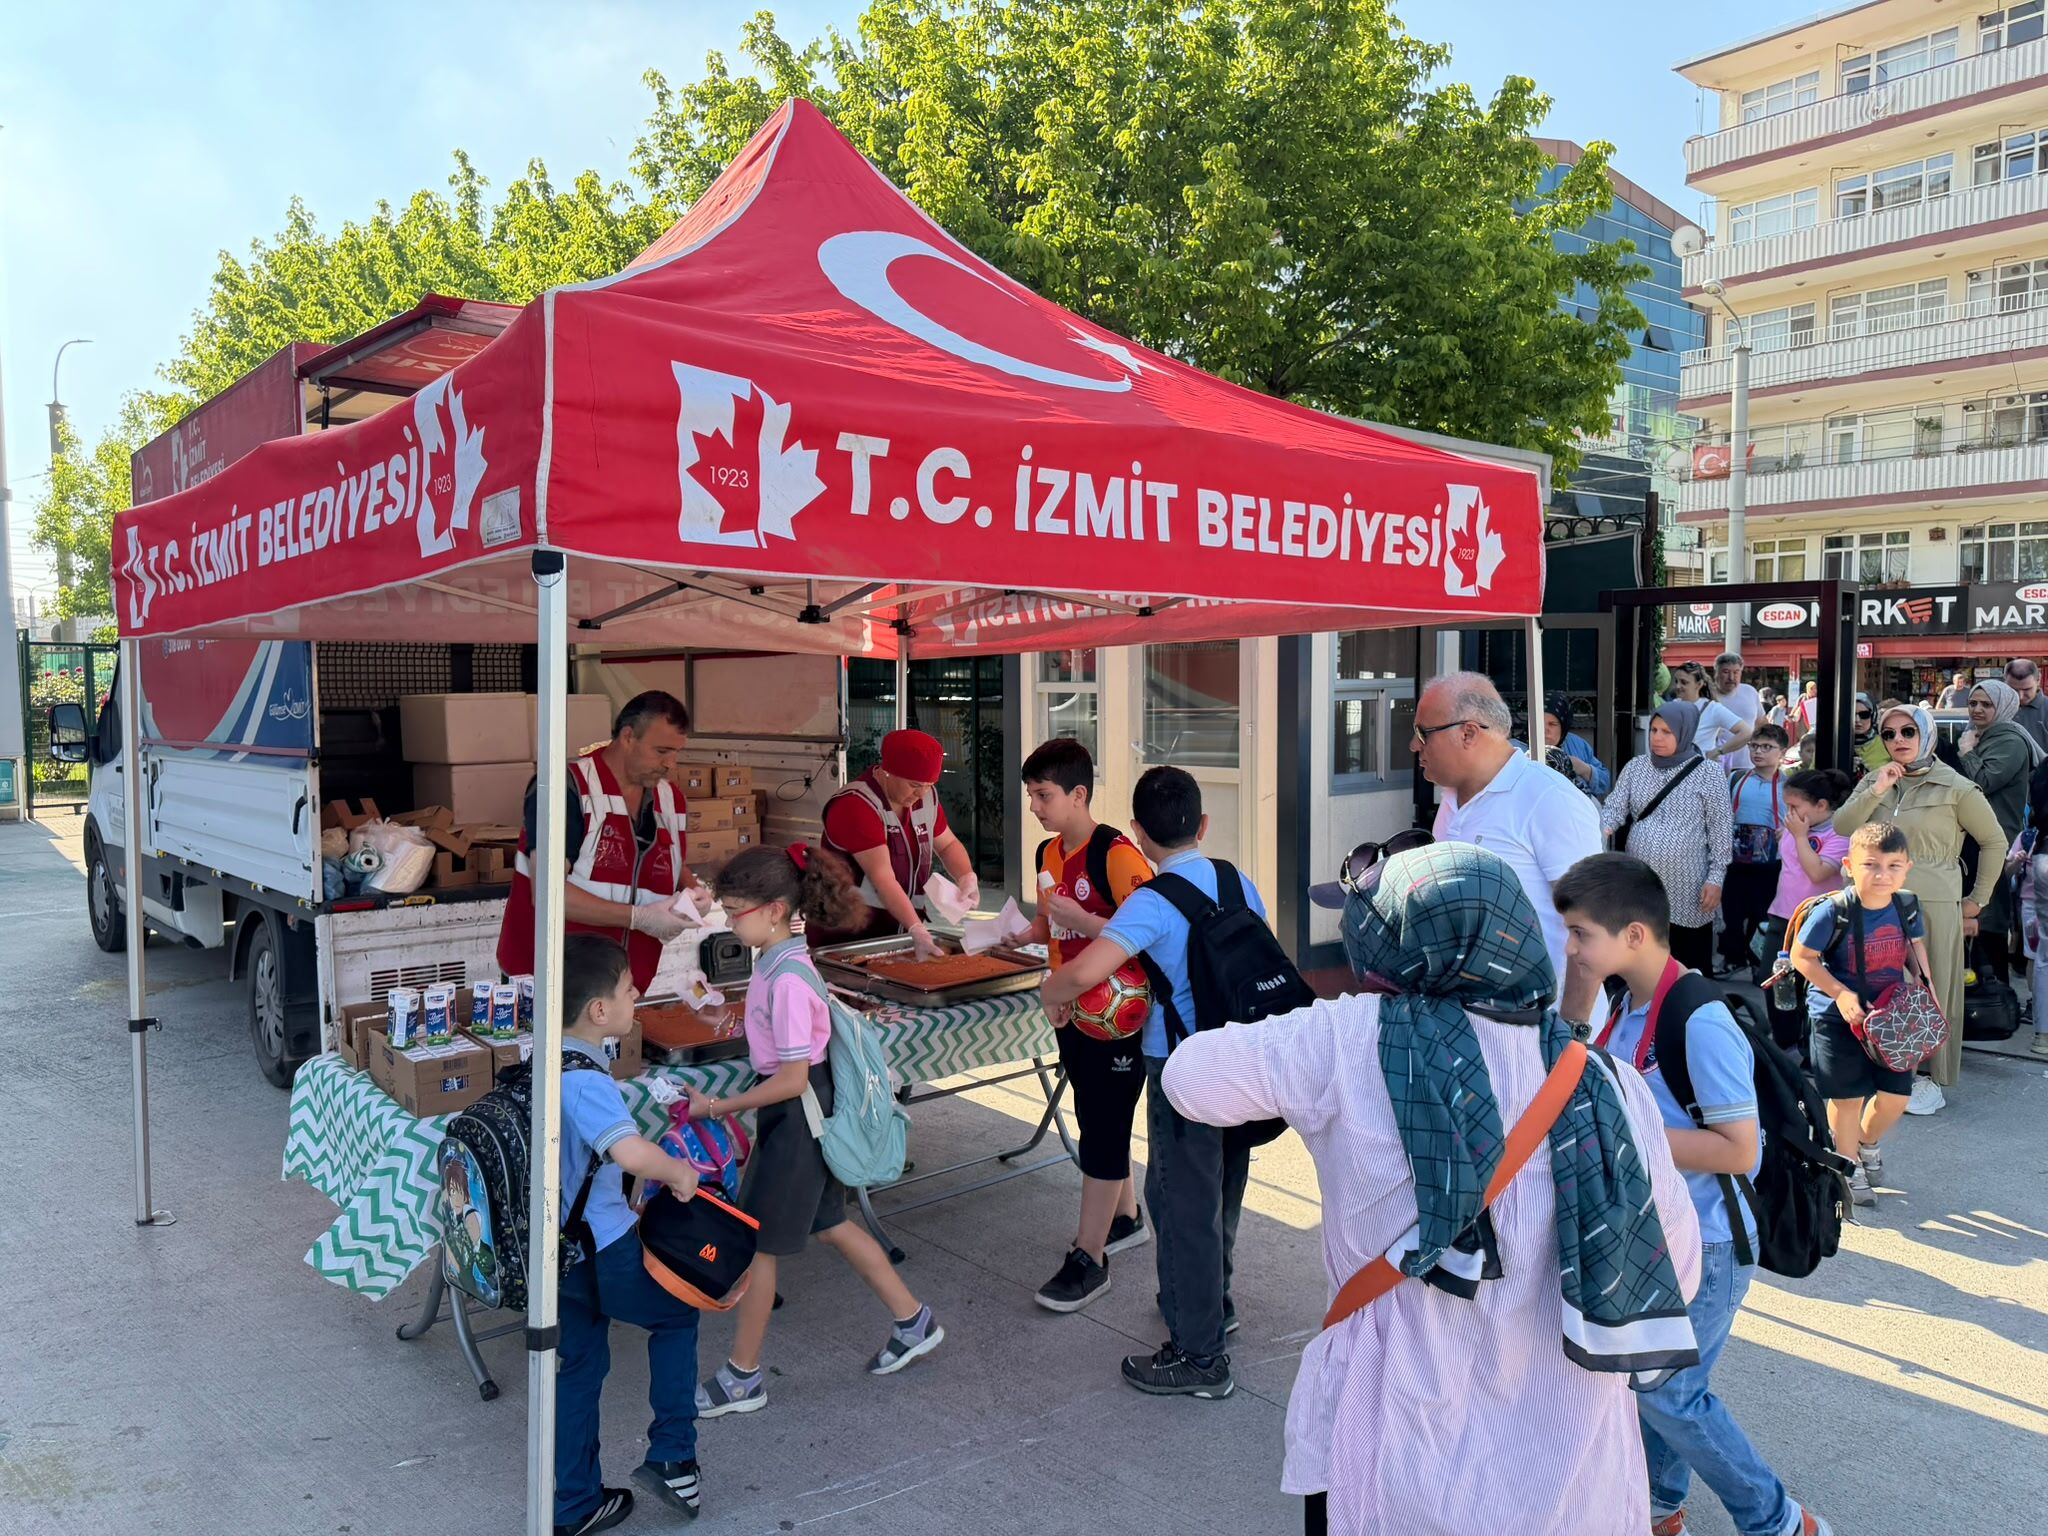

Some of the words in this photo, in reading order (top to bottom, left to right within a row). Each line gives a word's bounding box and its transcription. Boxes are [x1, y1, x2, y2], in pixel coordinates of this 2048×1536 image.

[434, 473, 452, 496] 1923
[709, 465, 749, 488] 1923
[148, 540, 194, 597] T.C.
[191, 504, 252, 587] İZMİT
[258, 425, 418, 567] BELEDİYESİ
[835, 432, 993, 528] T.C.
[1014, 445, 1178, 542] İZMİT
[1197, 488, 1442, 568] BELEDİYESİ
[1457, 547, 1475, 560] 1923
[2023, 588, 2048, 600] ESC
[1763, 610, 1801, 621] ESCAN
